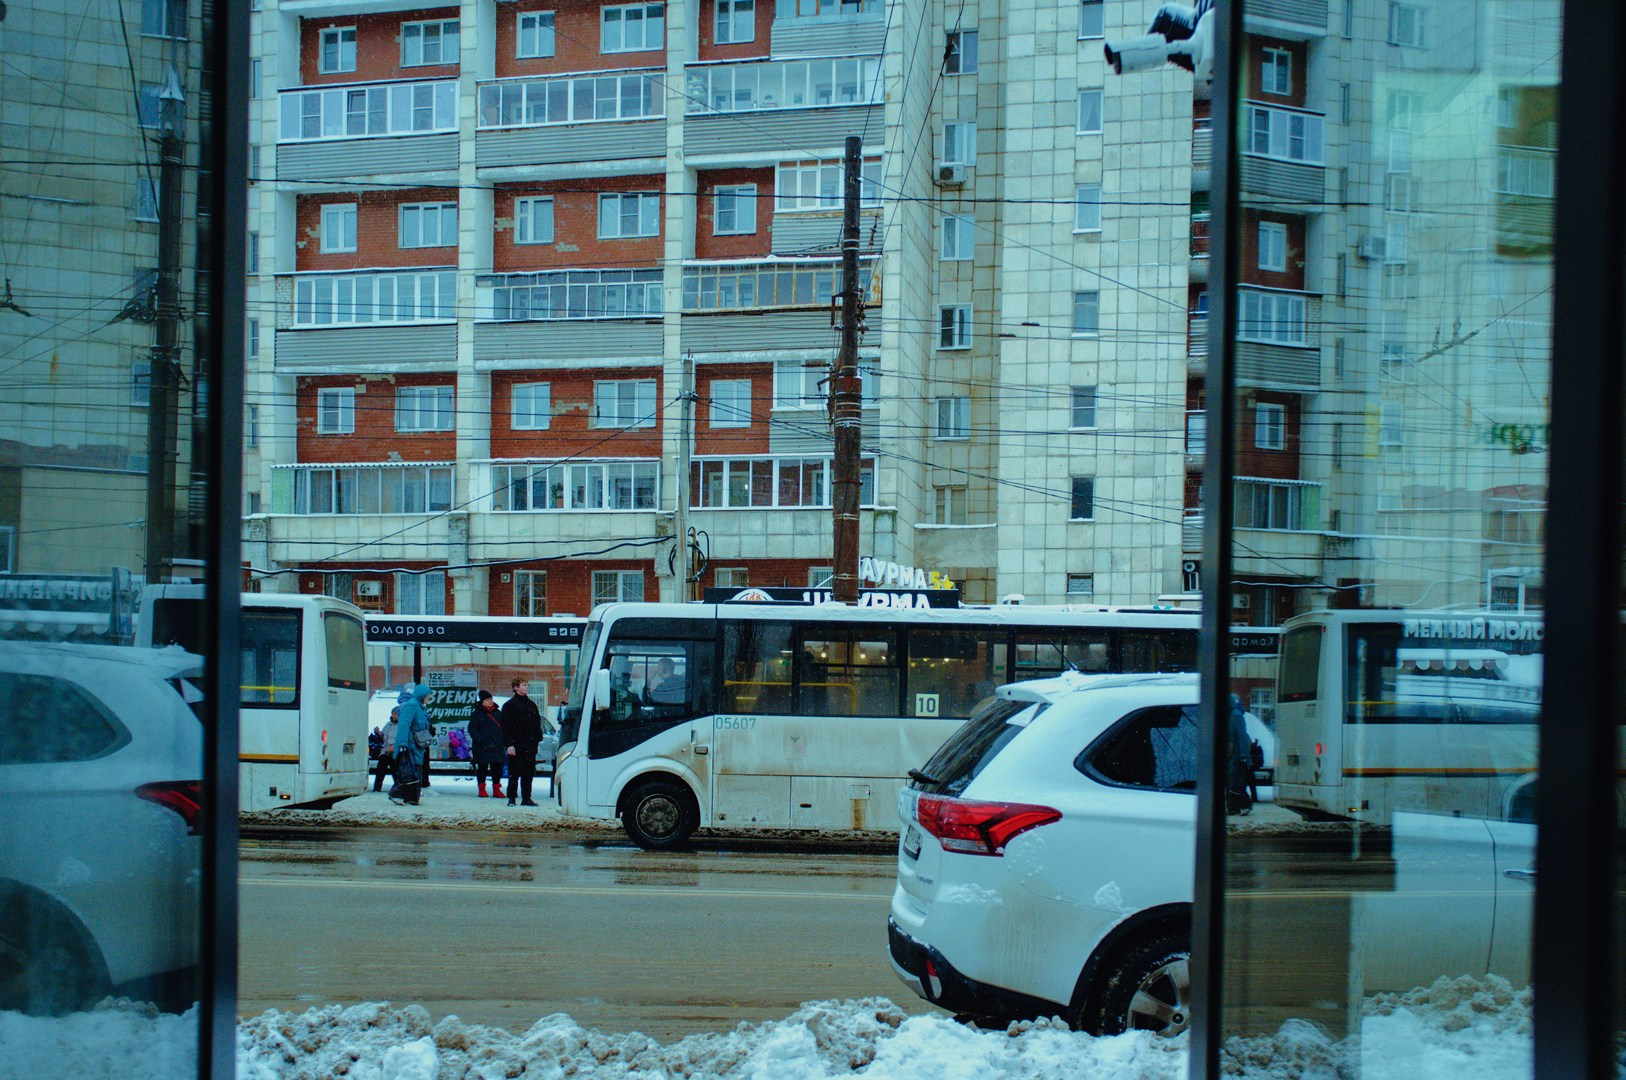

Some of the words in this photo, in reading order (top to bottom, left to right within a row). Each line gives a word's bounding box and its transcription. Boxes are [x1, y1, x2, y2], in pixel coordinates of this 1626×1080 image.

[859, 557, 927, 589] АУРМА
[930, 571, 941, 590] 5
[366, 625, 445, 636] омарова
[428, 672, 443, 680] 122
[917, 697, 937, 713] 10
[426, 706, 475, 718] служит
[715, 717, 757, 730] 05607
